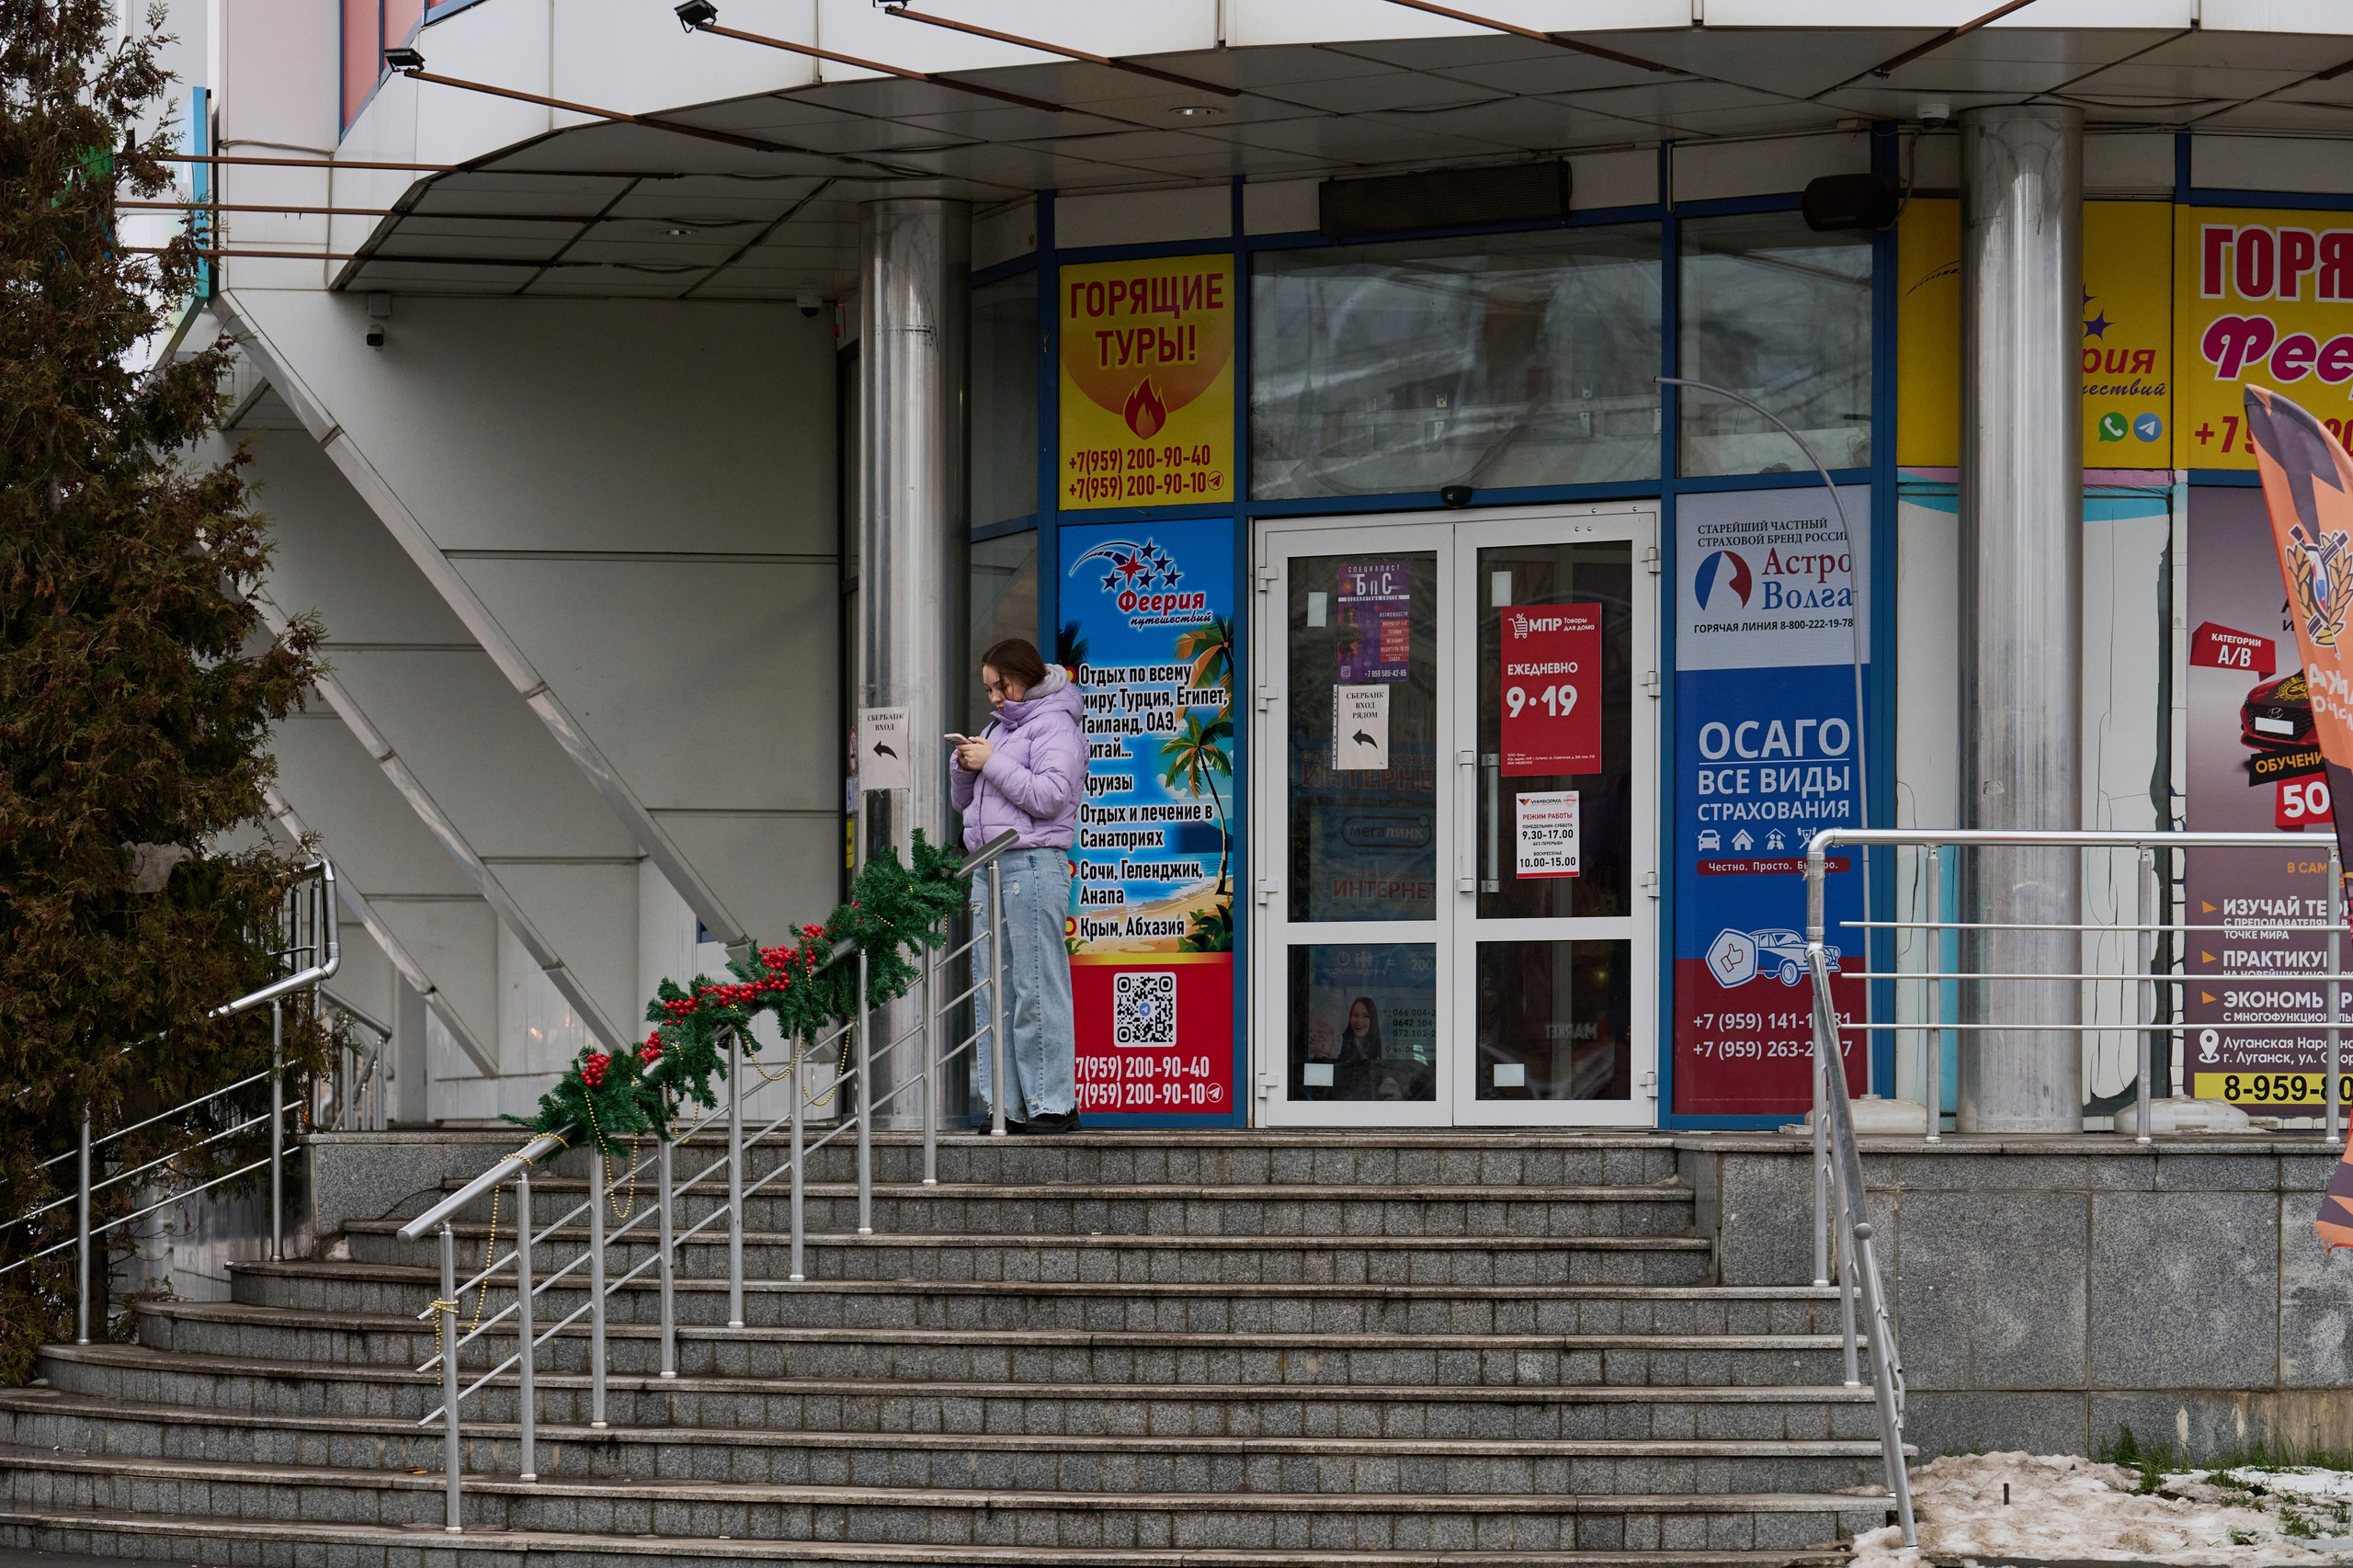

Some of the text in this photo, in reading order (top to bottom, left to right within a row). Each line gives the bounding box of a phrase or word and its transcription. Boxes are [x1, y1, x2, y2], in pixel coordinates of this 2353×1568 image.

[2200, 223, 2353, 302] ГОРЯ
[1070, 273, 1224, 319] ГОРЯЩИЕ
[1096, 324, 1196, 366] ТУРЫ!
[2083, 347, 2156, 374] рия
[2083, 378, 2165, 396] ествий
[1069, 444, 1211, 475] +7(959) 200-90-40
[1069, 472, 1207, 502] +7(959) 200-90-10
[1698, 517, 1828, 535] СТАРЕЙШИЙ ЧАСТНЫЙ
[1698, 533, 1765, 548] СТРАХОВОЙ
[1767, 533, 1802, 545] БРЕНД
[1347, 564, 1401, 573] СПЕЦИАЛИСТ
[1761, 547, 1852, 584] Астро
[1118, 590, 1205, 616] Феерия
[1762, 581, 1853, 610] Волга
[1130, 610, 1212, 630] путешествий
[1529, 618, 1563, 631] МПР
[1694, 619, 1853, 633] ГОРЯЧАЯ ЛИНИЯ 8-800-222-19-78
[2211, 632, 2261, 647] КАТЕГОРИИ
[1080, 664, 1192, 687] Отдых по всему
[1507, 662, 1578, 676] ЕЖЕДНЕВНО
[1120, 688, 1174, 710] Турция,
[1176, 687, 1228, 707] Египет,
[868, 713, 904, 722] СБЕРБАНК
[1082, 711, 1177, 735] Таиланд, ОАЭ,
[1089, 738, 1132, 758] итай...
[1699, 718, 1850, 760] ОСАГО
[1083, 773, 1133, 796] Круизы
[1699, 766, 1849, 799] ВСЕ ВИДЫ
[2283, 781, 2330, 818] 50
[1080, 803, 1212, 825] Отдых и лечение в
[1698, 800, 1849, 821] СТРАХОВАНИЯ
[1080, 828, 1164, 851] Санаториях
[1522, 829, 1574, 840] 9.30-17.00
[1081, 859, 1203, 881] Сочи, Геленджик,
[1520, 857, 1575, 868] 10.00-15.00
[1709, 860, 1838, 872] Честно. Просто. Быро.
[2288, 862, 2295, 873] В
[1080, 885, 1124, 904] Анапа
[2223, 895, 2349, 916] ИЗУЧАЙ ТЕ
[1081, 916, 1185, 941] Крым, Абхазия
[2223, 918, 2232, 926] С
[2224, 930, 2290, 939] ТОЧКЕ МИРА
[2223, 991, 2353, 1008] ЭКОНОМЬ Р
[1693, 1012, 1851, 1032] +7 (959) 141-181
[2223, 1013, 2232, 1021] С
[1693, 1041, 1714, 1058] +7
[1718, 1040, 1763, 1061] (959)
[2223, 1036, 2294, 1051] Луганская
[1074, 1055, 1210, 1082] 7(959) 200-90-40
[2223, 1053, 2233, 1063] г.
[2236, 1051, 2294, 1065] Луганск,
[2299, 1053, 2317, 1065] ул.
[1074, 1082, 1205, 1108] 7(959) 200-90-10
